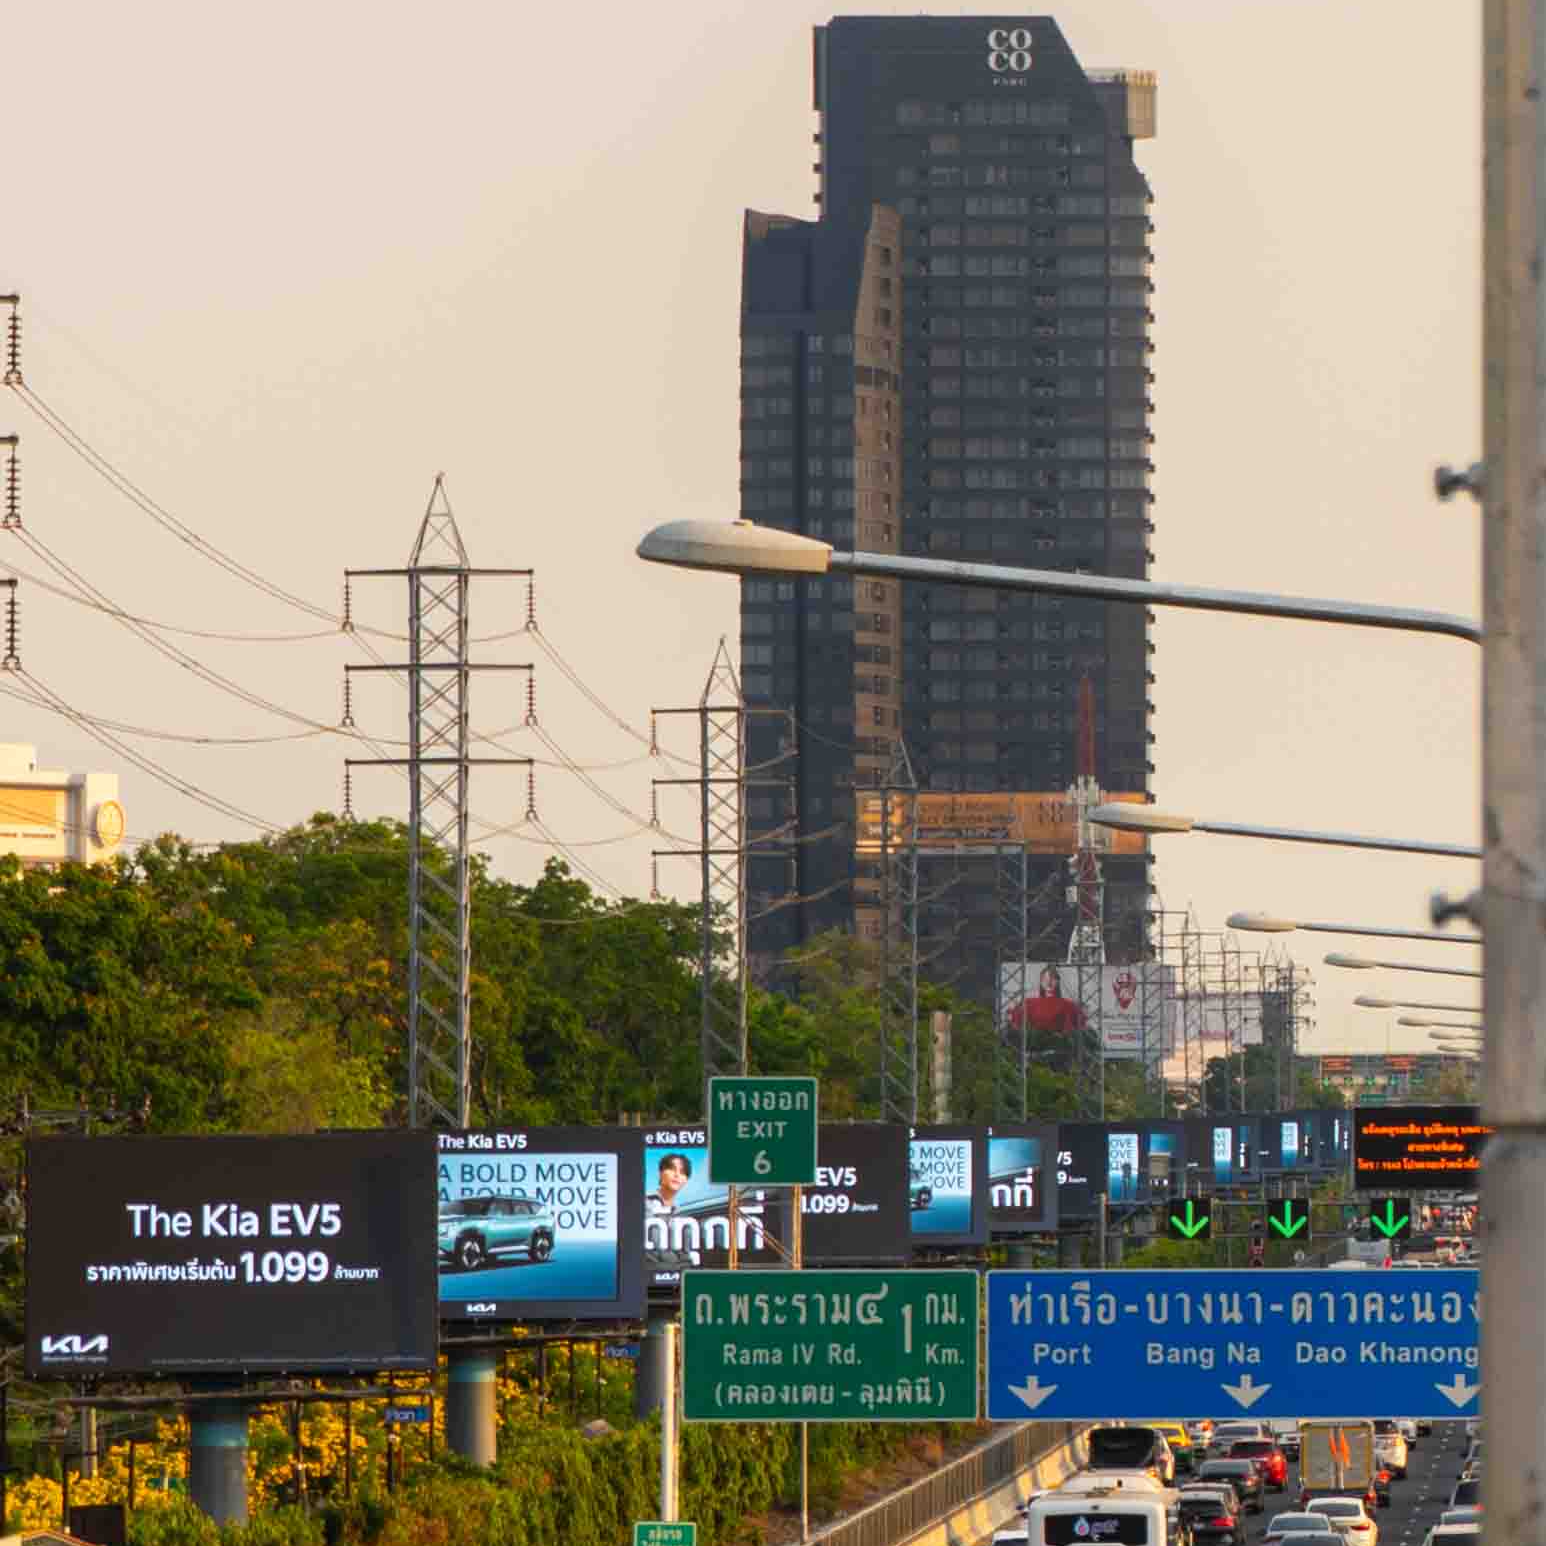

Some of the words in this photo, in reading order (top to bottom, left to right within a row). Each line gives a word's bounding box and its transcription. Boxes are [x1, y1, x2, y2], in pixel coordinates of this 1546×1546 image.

[719, 1091, 808, 1111] ทางออก
[656, 1132, 677, 1144] Kia
[680, 1132, 705, 1144] EV5
[737, 1121, 788, 1138] EXIT
[437, 1135, 464, 1149] The
[467, 1135, 493, 1149] Kia
[496, 1135, 528, 1149] EV5
[753, 1150, 772, 1174] 6
[919, 1146, 965, 1160] MOVE
[460, 1163, 527, 1182] BOLD
[535, 1163, 609, 1182] MOVE
[815, 1167, 857, 1186] EV5
[919, 1161, 965, 1174] MOVE
[933, 1176, 965, 1189] OVE
[535, 1187, 609, 1205] MOVE
[126, 1204, 193, 1237] The
[203, 1203, 259, 1237] Kia
[270, 1204, 342, 1237] EV5
[552, 1210, 609, 1230] OVE
[87, 1257, 236, 1281] ราคาพิเศษเริ่มต้น
[240, 1251, 329, 1283] 1.099
[695, 1281, 889, 1325] ถ.พระราม๔
[901, 1303, 913, 1354] 1
[925, 1292, 966, 1325] กม.
[723, 1343, 783, 1365] Rama
[793, 1343, 815, 1365] IV
[828, 1343, 862, 1365] Rd.
[925, 1343, 966, 1365] Km.
[1032, 1343, 1091, 1365] Port
[1146, 1343, 1215, 1371] Bang
[1227, 1343, 1261, 1364] Na
[1296, 1343, 1346, 1364] Dao
[1359, 1342, 1480, 1369] Khanong
[859, 1376, 946, 1410] ลุมพินี)
